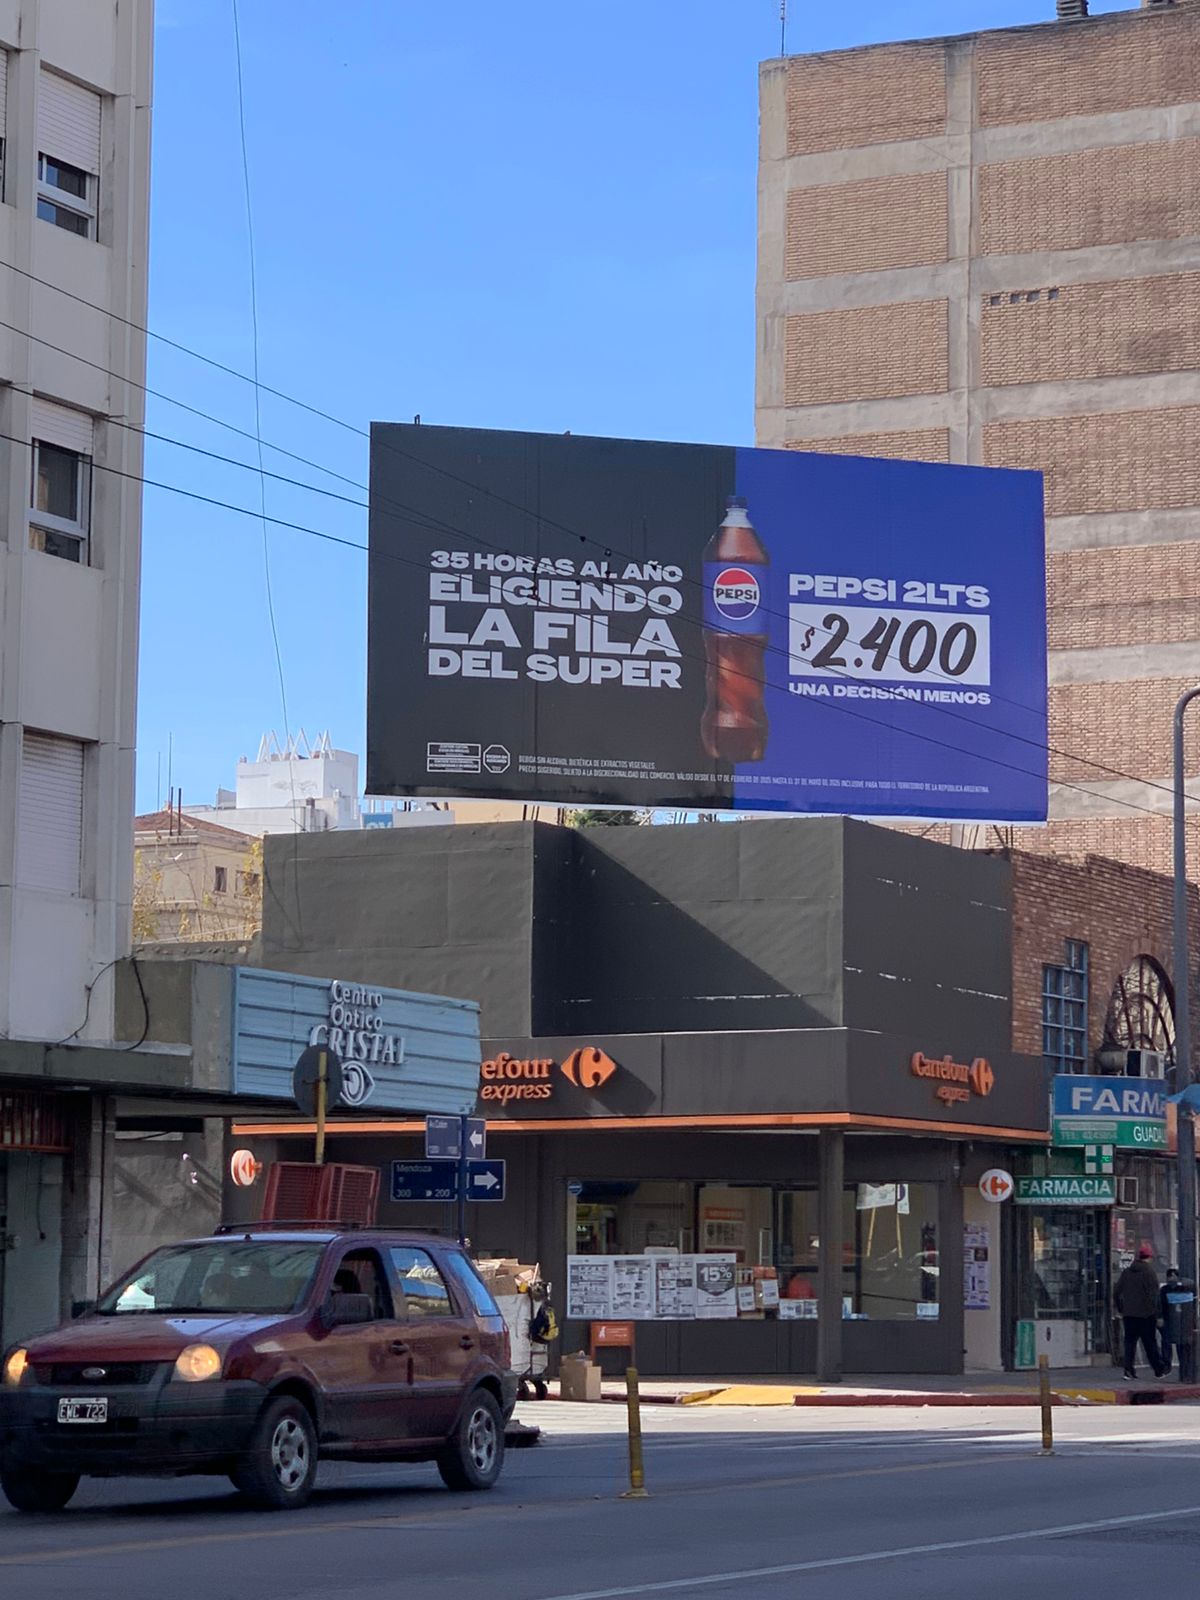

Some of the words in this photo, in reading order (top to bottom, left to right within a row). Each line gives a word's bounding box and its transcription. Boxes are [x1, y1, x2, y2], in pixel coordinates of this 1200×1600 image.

[430, 550, 469, 569] 35
[473, 553, 575, 576] HORAS
[580, 561, 617, 579] AL
[622, 560, 683, 583] AÑO
[429, 572, 683, 615] ELIGIENDO
[715, 587, 757, 601] PEPSI
[789, 573, 896, 602] PEPSI
[902, 580, 990, 608] 2LTS
[429, 605, 522, 648] LA
[533, 611, 683, 658] FILA
[428, 648, 519, 680] DEL
[526, 653, 682, 689] SUPER
[788, 682, 830, 697] UNA
[833, 685, 920, 702] DECISIÓN
[924, 690, 991, 705] MENOS
[331, 980, 383, 1007] Centro
[481, 1052, 553, 1079] efour
[911, 1051, 970, 1083] Carrefour
[481, 1083, 553, 1106] express
[396, 1164, 433, 1173] Mendoza
[434, 1188, 450, 1198] 200
[1020, 1180, 1112, 1195] FARMACIA
[700, 1266, 733, 1282] 15%
[86, 1404, 105, 1418] 722
